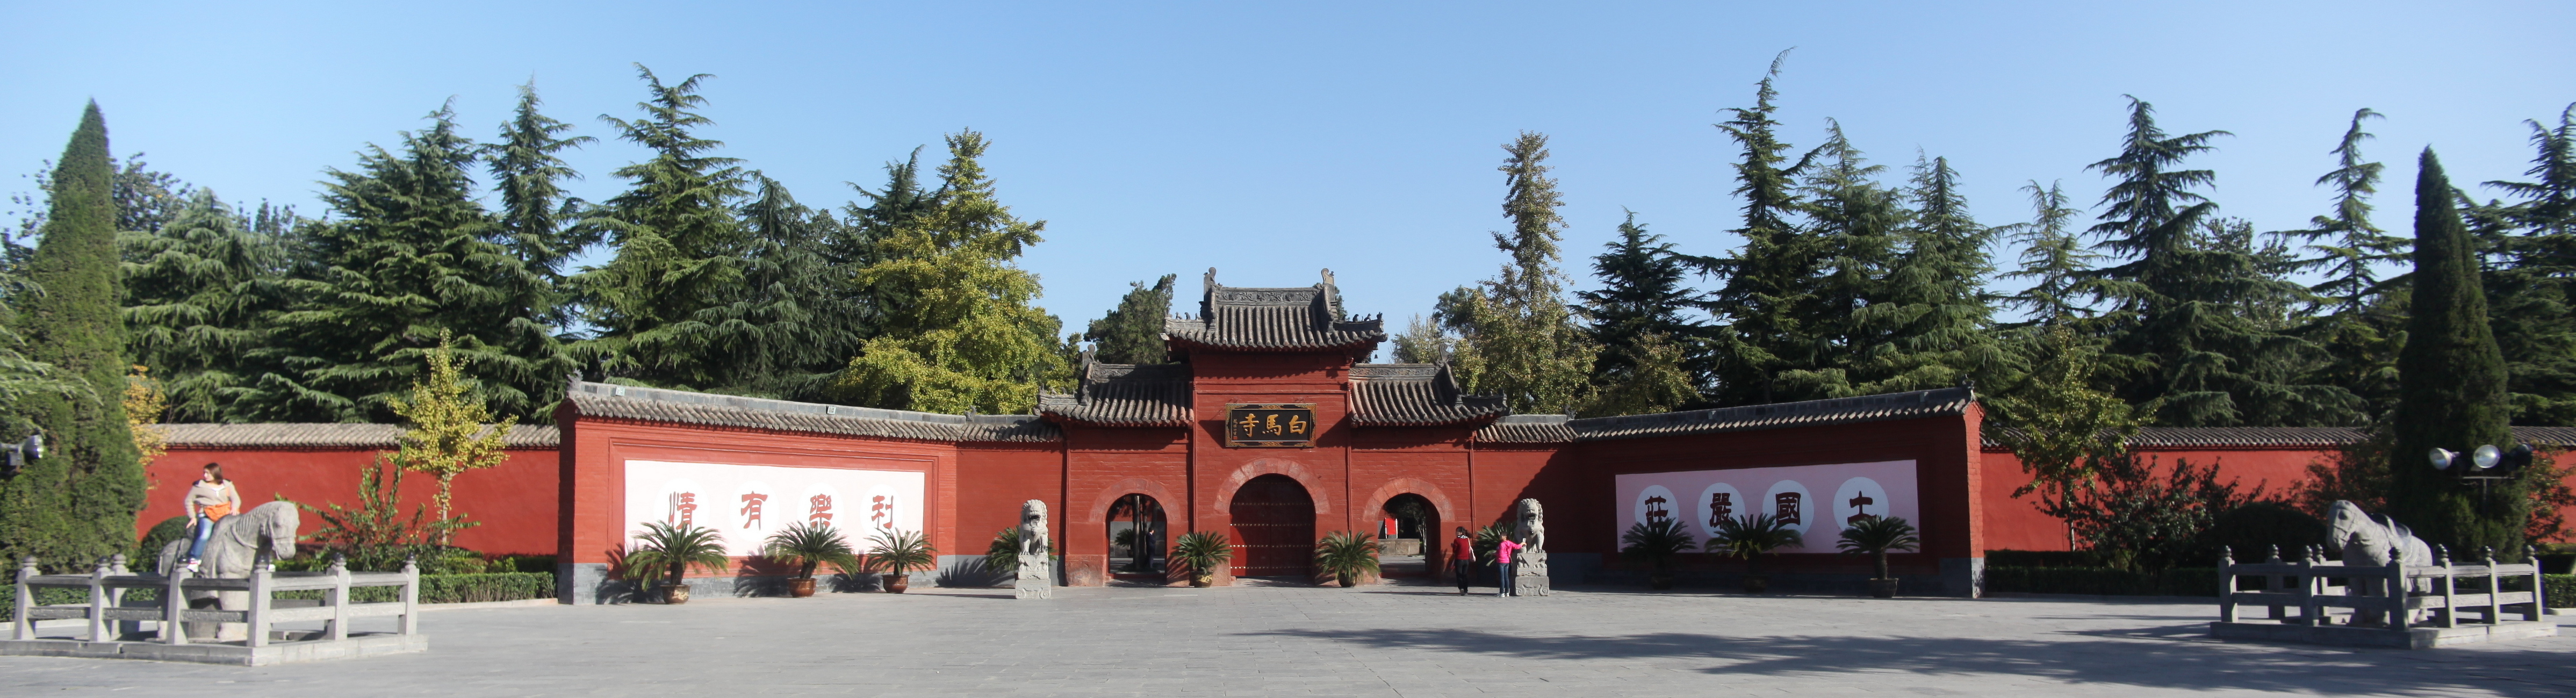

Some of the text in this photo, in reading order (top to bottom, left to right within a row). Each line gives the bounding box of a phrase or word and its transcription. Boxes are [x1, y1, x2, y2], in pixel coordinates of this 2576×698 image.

[1239, 413, 1307, 437] 白馬寺
[1644, 490, 1878, 530] 莊嚴國土
